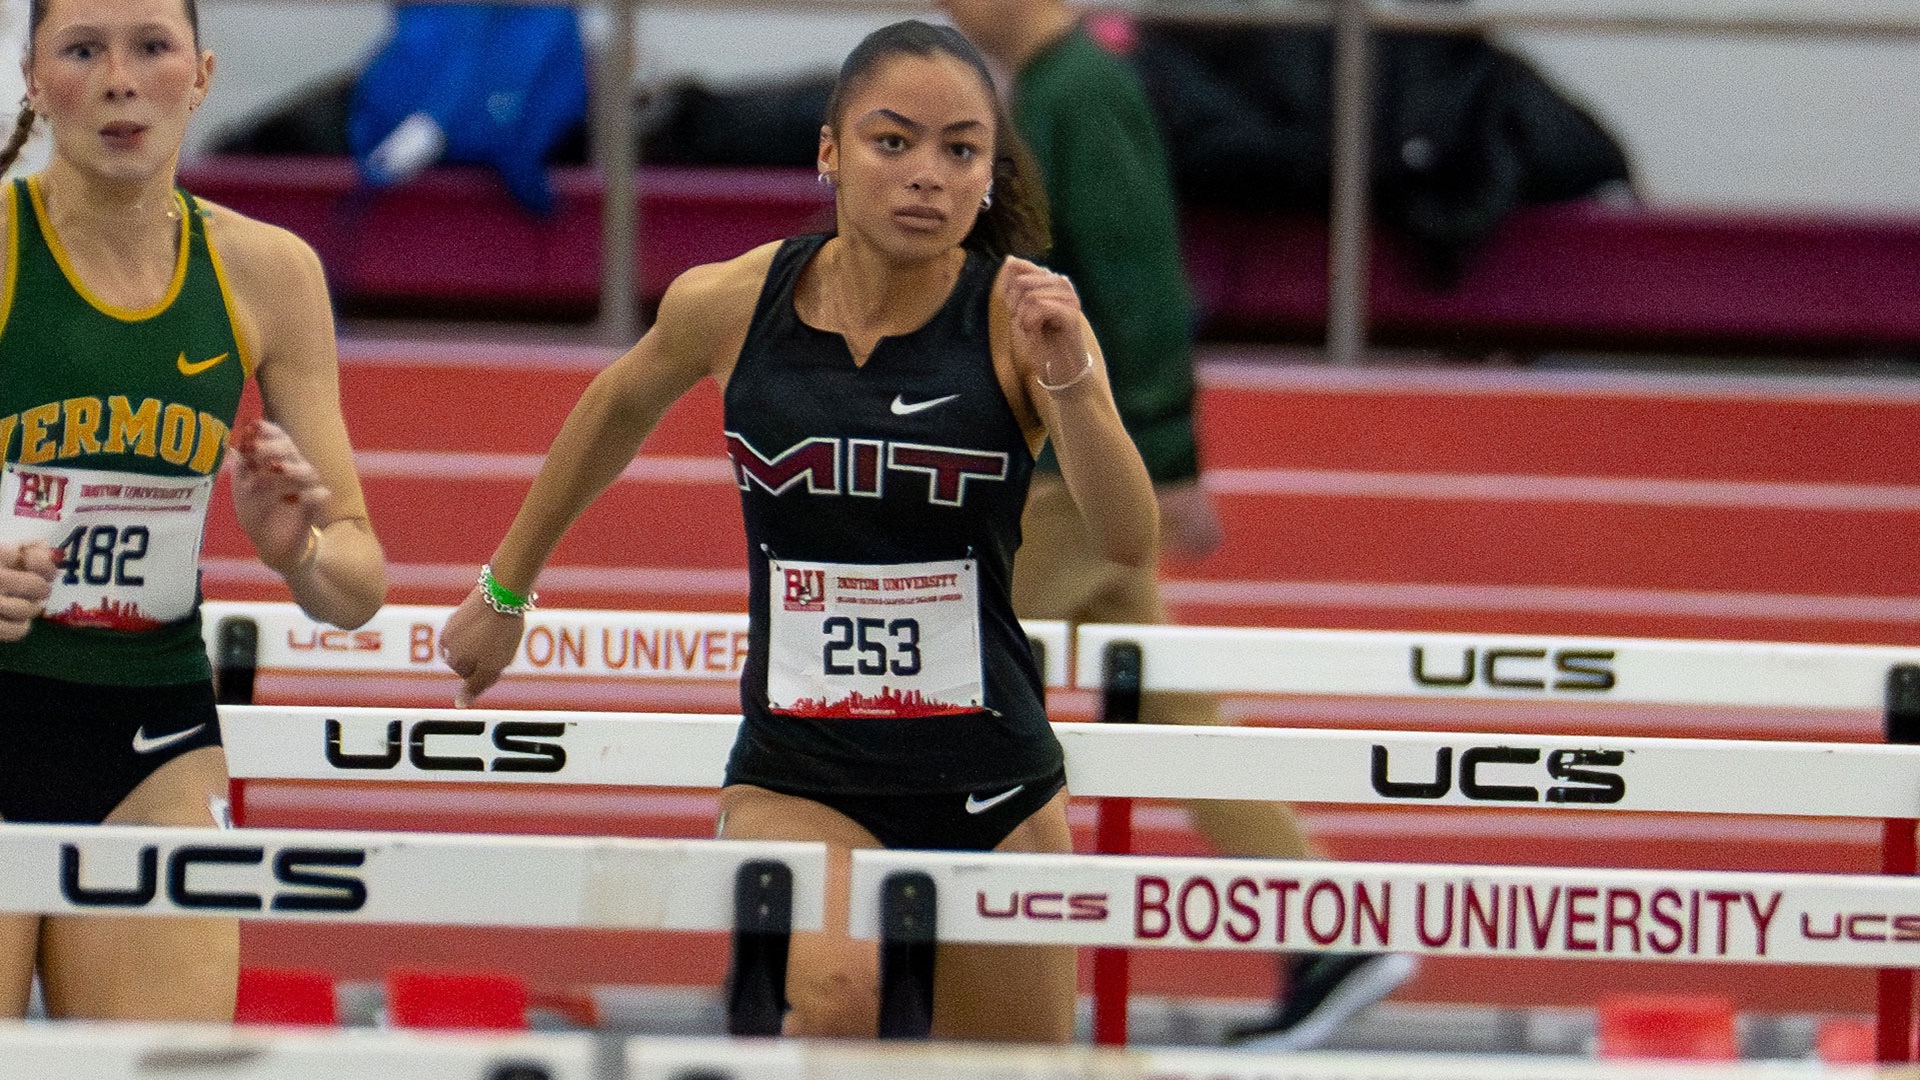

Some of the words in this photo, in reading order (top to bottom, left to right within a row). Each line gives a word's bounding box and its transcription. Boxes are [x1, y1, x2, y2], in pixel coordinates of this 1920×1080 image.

[724, 431, 1009, 507] MIT
[56, 524, 150, 587] 482
[287, 628, 382, 652] UCS
[409, 622, 587, 670] BON
[822, 616, 922, 677] 253
[1411, 646, 1617, 692] UCS
[325, 718, 567, 774] UCS
[1370, 744, 1627, 805] UCS
[60, 843, 368, 913] UCS
[977, 890, 1109, 922] UCS
[1133, 874, 1393, 947] BOSTON
[1414, 880, 1784, 957] UNIVERSITY
